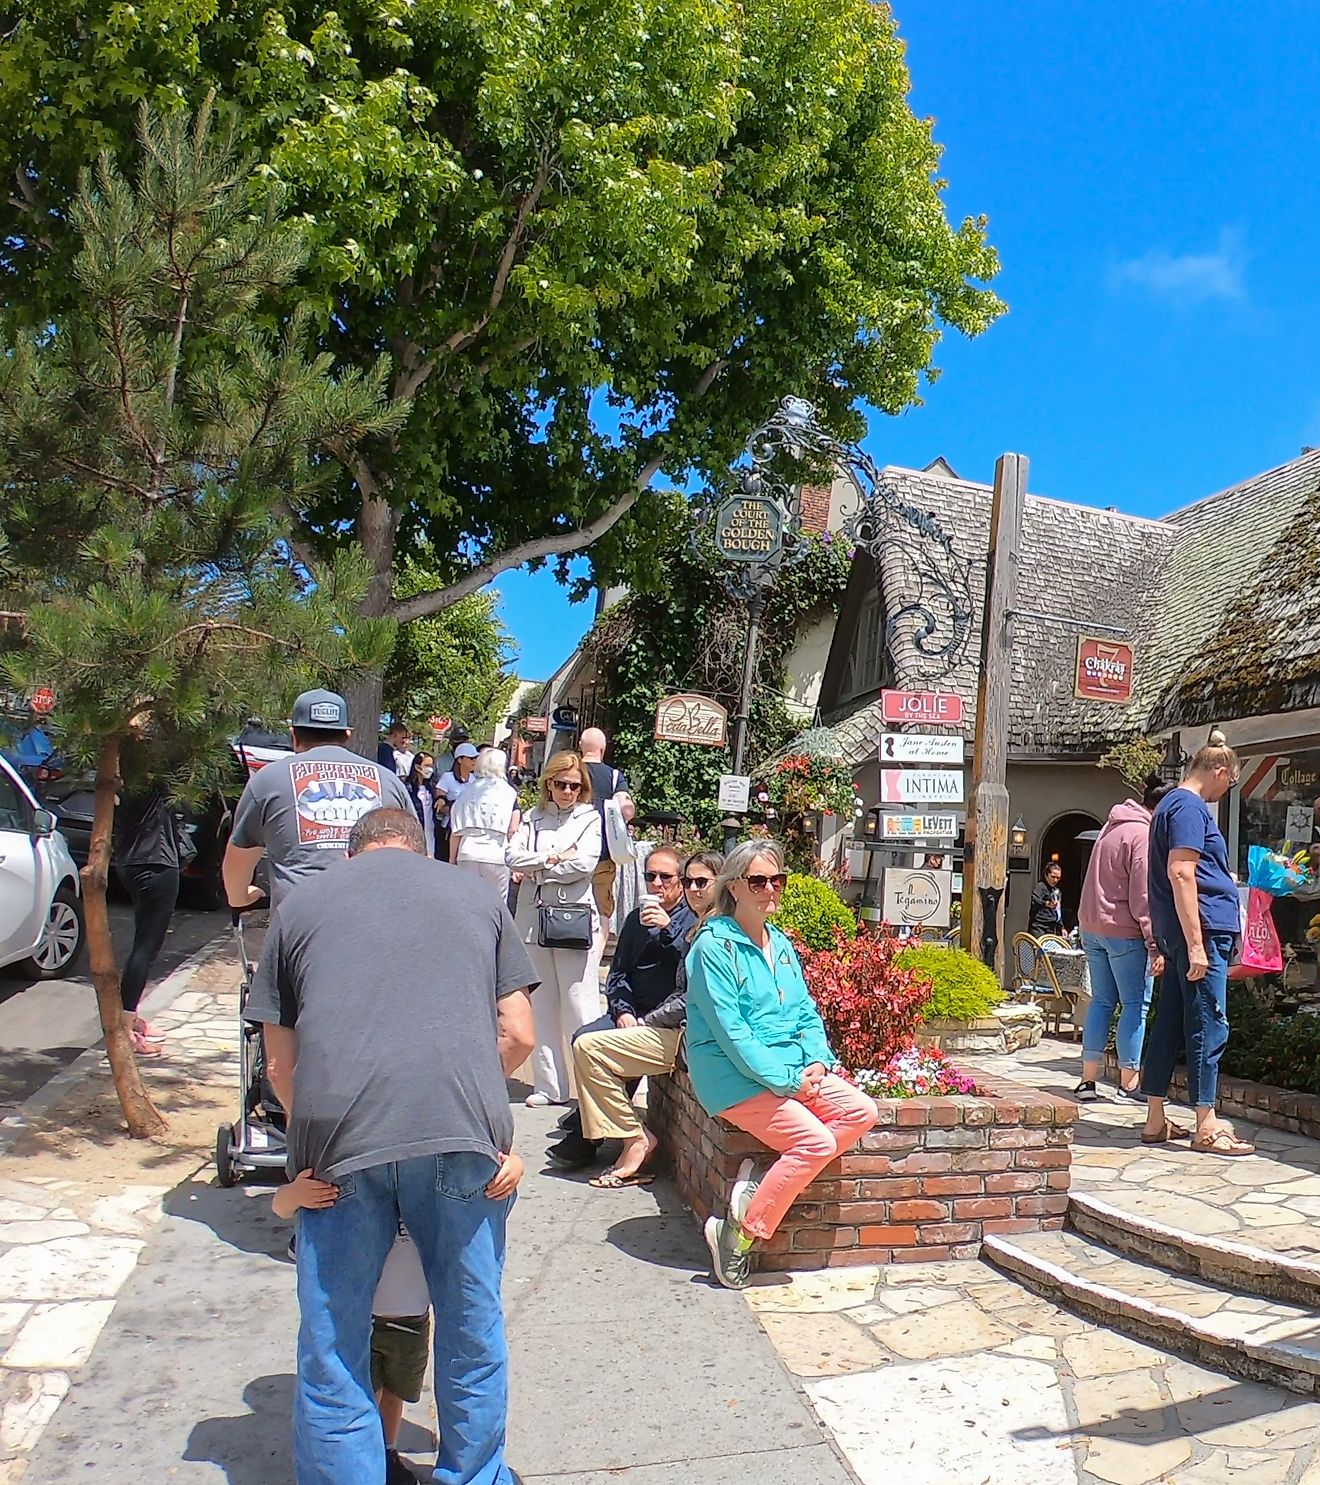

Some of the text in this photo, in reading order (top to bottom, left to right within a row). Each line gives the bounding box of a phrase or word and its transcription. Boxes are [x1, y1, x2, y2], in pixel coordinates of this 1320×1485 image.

[742, 501, 763, 510] THE
[733, 510, 770, 520] COURT
[731, 519, 769, 529] OF THE
[721, 527, 775, 540] GOLDEN
[723, 539, 771, 551] BOUGH
[33, 694, 52, 704] STOP
[898, 697, 948, 713] JOLIE
[900, 736, 958, 748] Jane Austen
[908, 747, 949, 756] at Home
[906, 778, 959, 794] INTIMA
[894, 891, 938, 910] Tegamino
